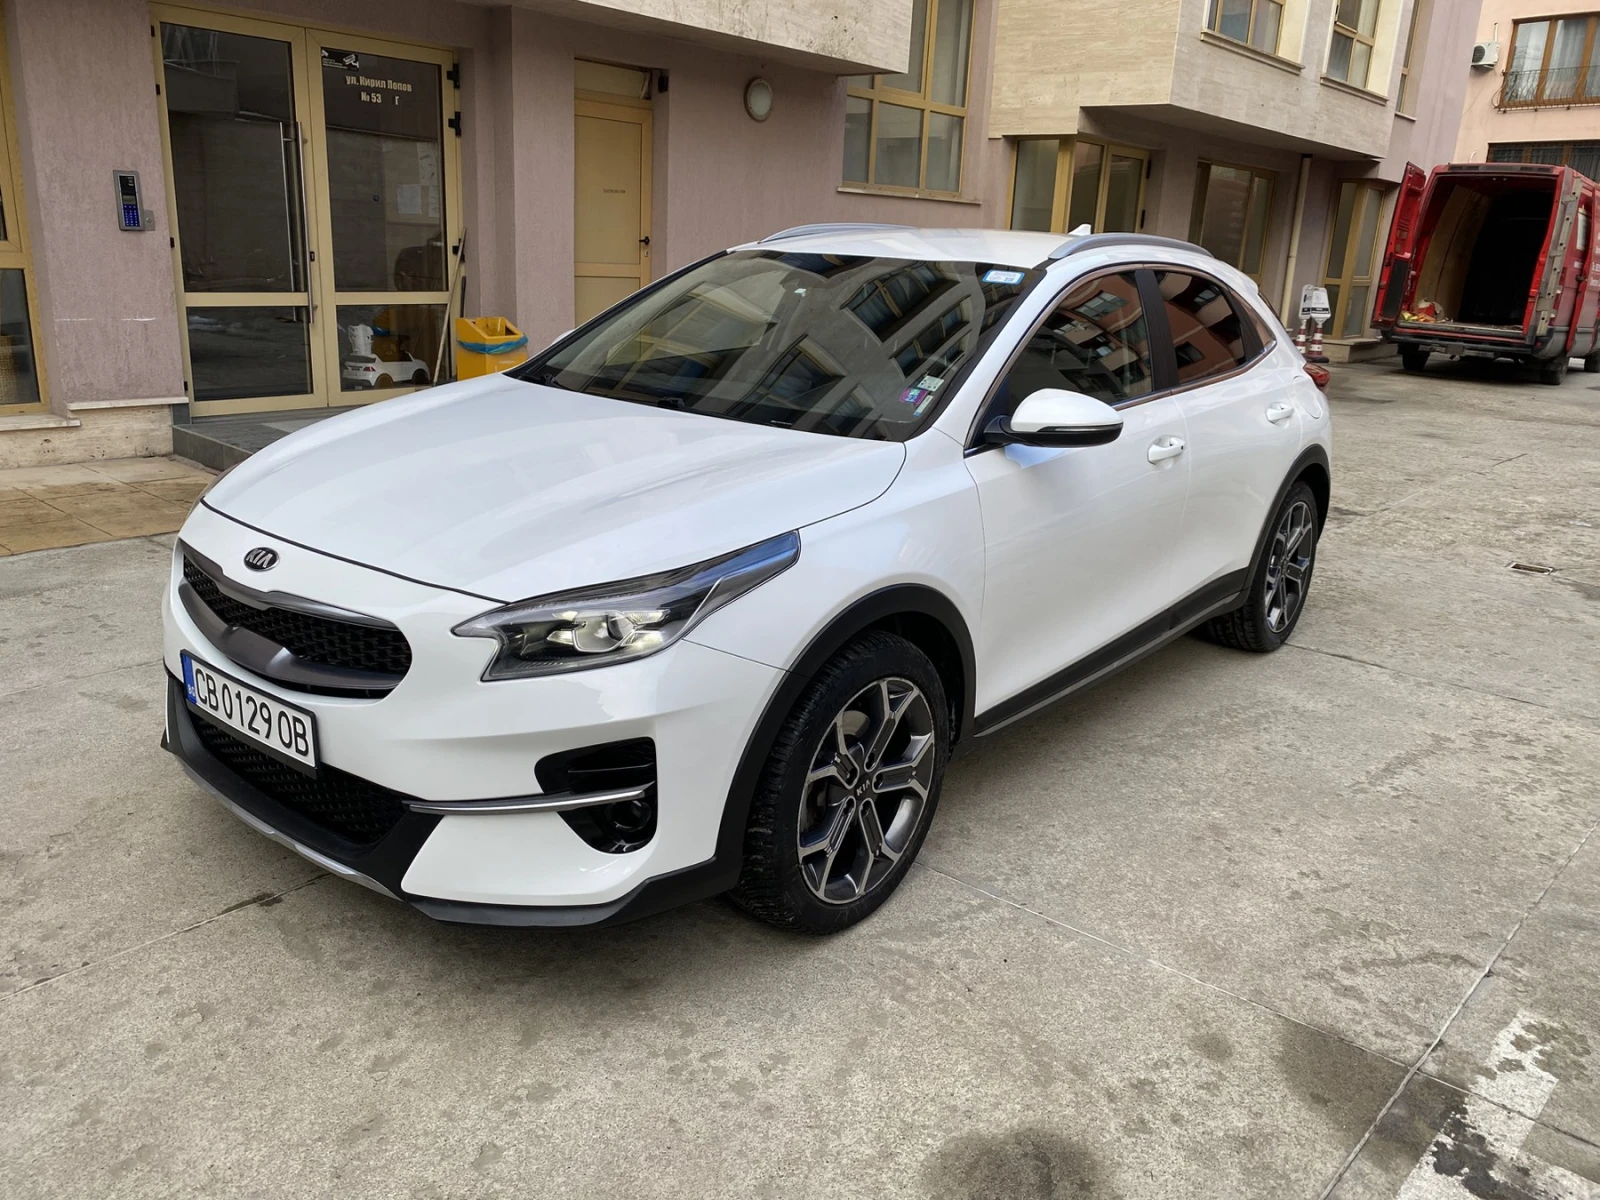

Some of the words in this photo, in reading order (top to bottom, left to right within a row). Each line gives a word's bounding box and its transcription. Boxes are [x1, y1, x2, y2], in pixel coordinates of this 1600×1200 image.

[360, 76, 386, 88] Кирил
[387, 80, 412, 92] Попов
[371, 93, 382, 103] 53
[245, 549, 273, 568] KIA
[856, 779, 871, 796] KIA
